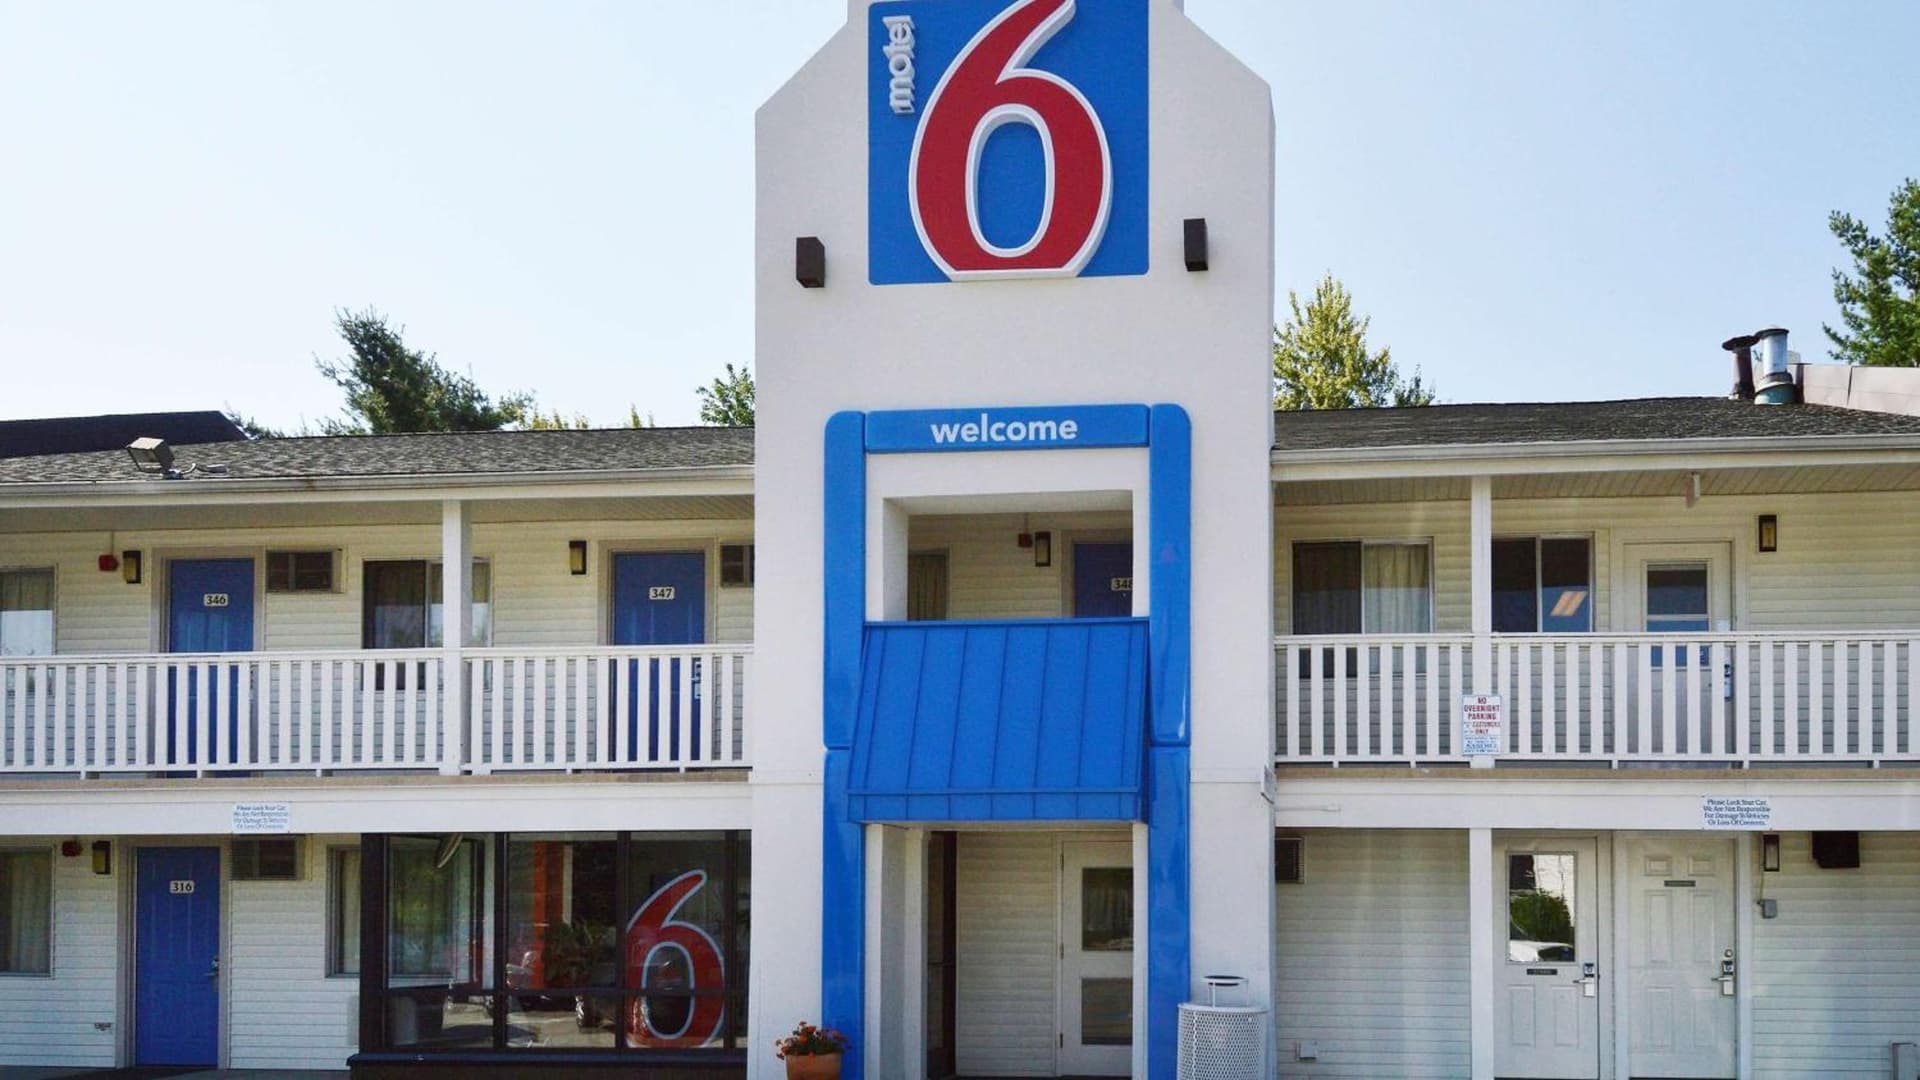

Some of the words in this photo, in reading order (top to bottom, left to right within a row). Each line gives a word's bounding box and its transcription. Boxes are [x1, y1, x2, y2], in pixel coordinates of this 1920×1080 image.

[882, 15, 915, 114] motel
[908, 0, 1113, 281] 6
[930, 413, 1078, 443] welcome
[207, 595, 226, 605] 346
[651, 588, 673, 599] 347
[173, 882, 192, 891] 316
[625, 869, 724, 1048] 6
